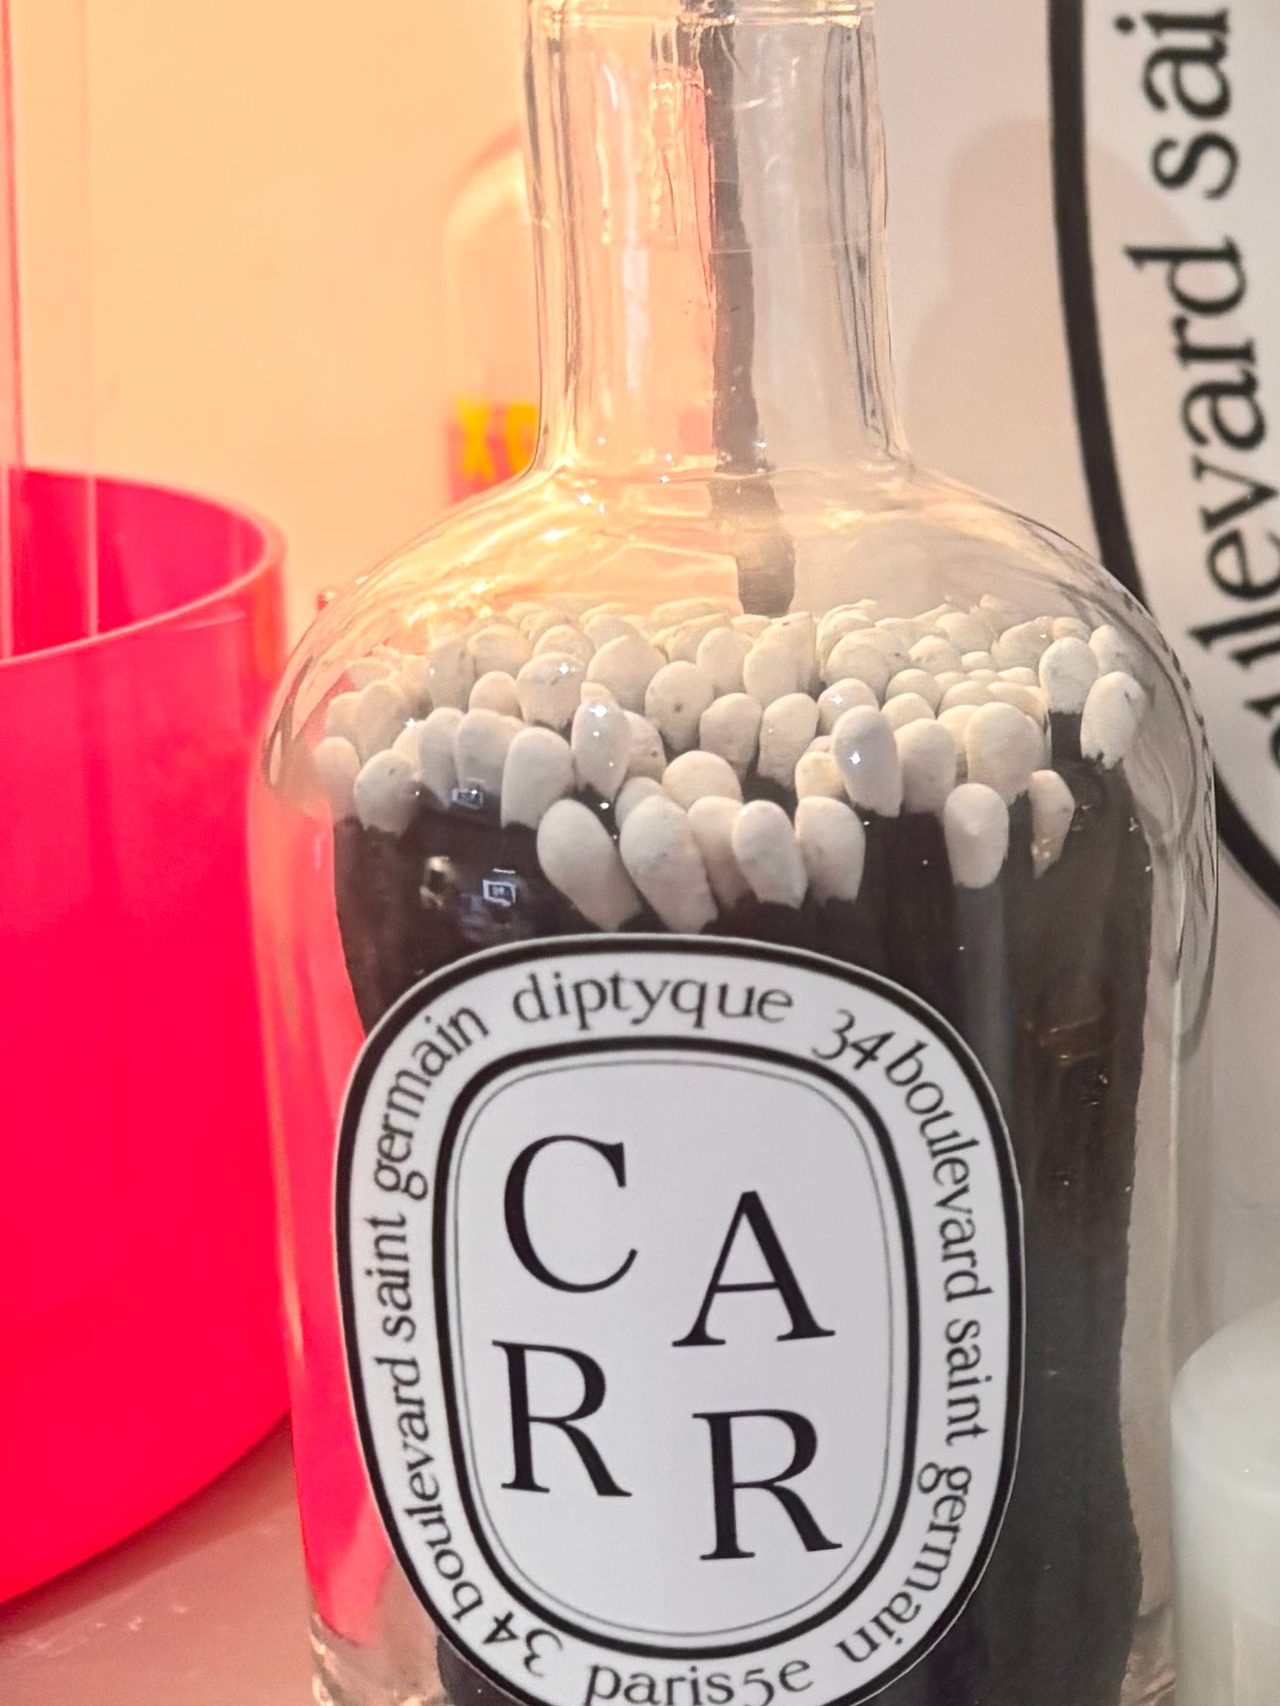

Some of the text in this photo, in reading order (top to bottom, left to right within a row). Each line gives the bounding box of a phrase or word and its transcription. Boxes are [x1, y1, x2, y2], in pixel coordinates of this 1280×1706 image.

[513, 970, 794, 1030] diptyque
[375, 1006, 490, 1200] germain
[365, 1214, 415, 1341] saint
[946, 1319, 994, 1446] saint
[375, 1355, 484, 1622] boulevard
[837, 1463, 973, 1664] germain
